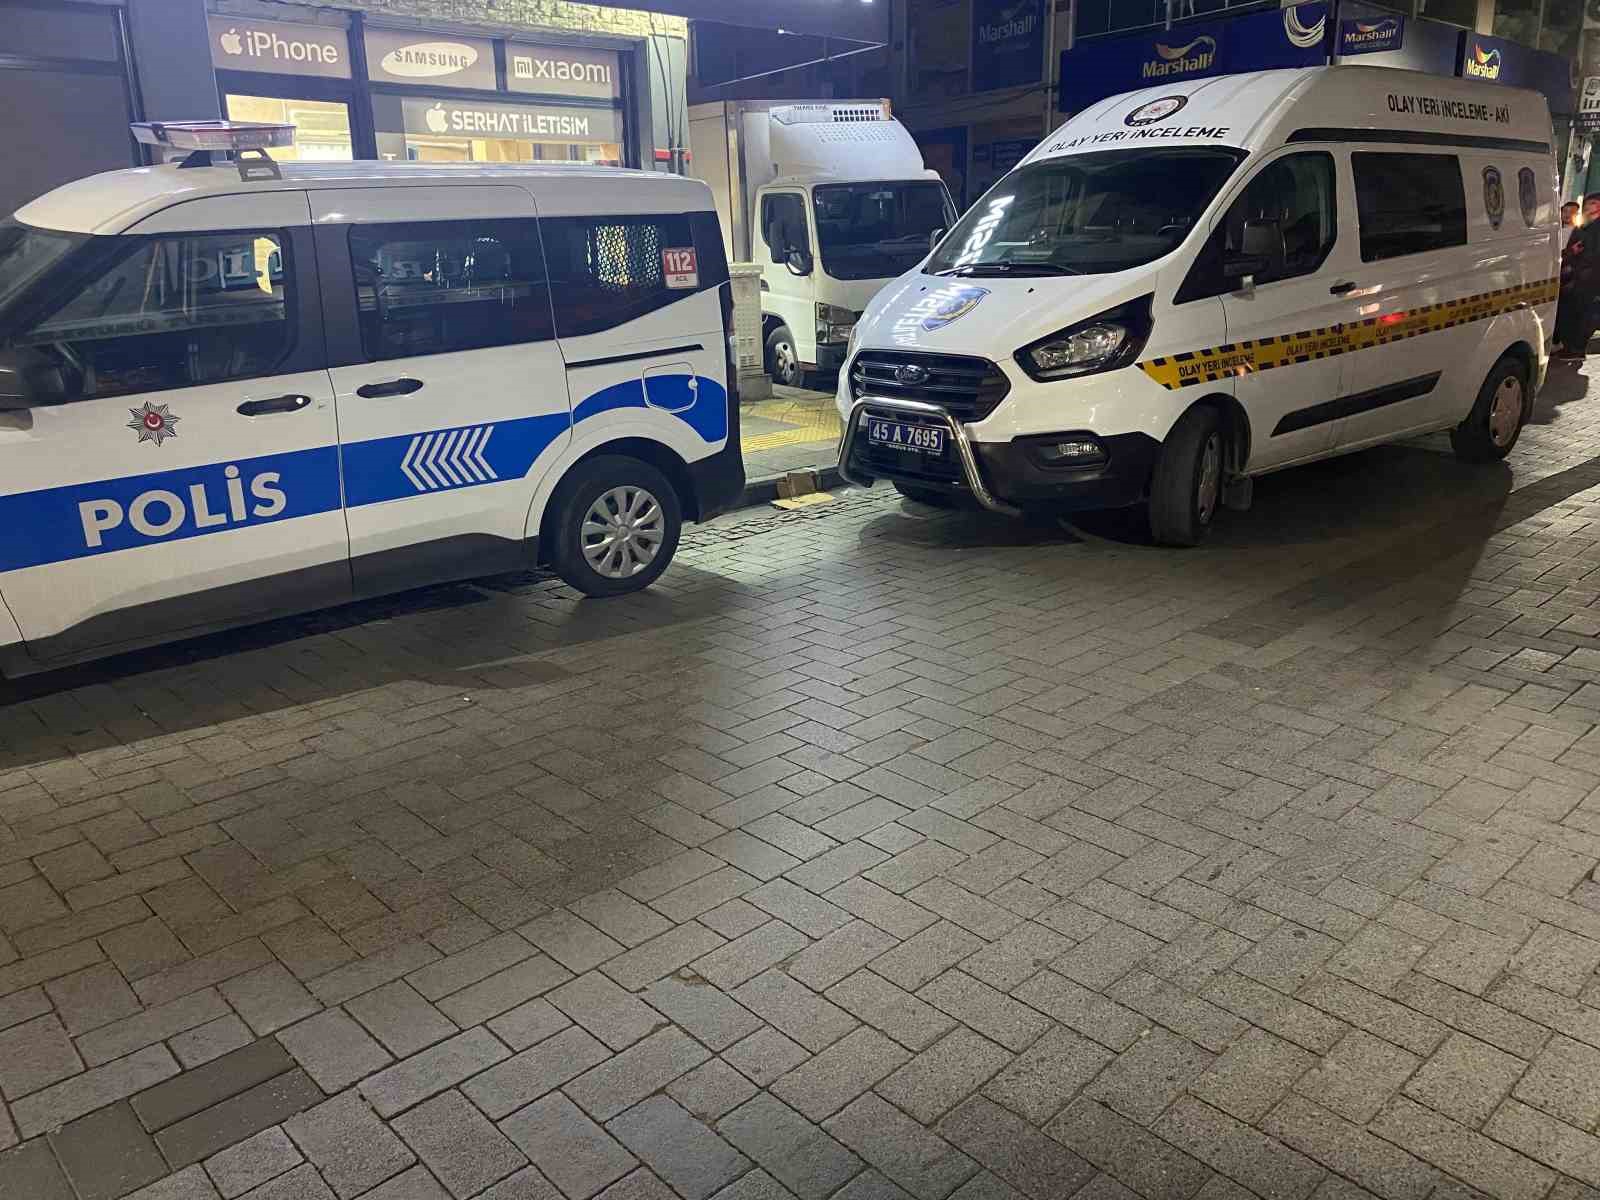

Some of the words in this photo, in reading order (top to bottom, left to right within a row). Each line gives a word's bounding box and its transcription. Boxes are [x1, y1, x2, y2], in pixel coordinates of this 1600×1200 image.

[1344, 30, 1393, 43] Marshall
[246, 31, 338, 64] iPhone
[394, 50, 470, 68] SAMSUNG
[1142, 54, 1211, 78] Marshall
[1466, 59, 1500, 79] Marshall
[1387, 94, 1418, 114] OLAY
[452, 111, 519, 133] SERHAT
[1049, 136, 1091, 152] OLAY
[667, 252, 692, 271] 112
[1178, 363, 1201, 378] OLAY
[873, 423, 889, 440] 45
[893, 425, 902, 442] A
[907, 427, 938, 448] 7695
[78, 465, 287, 548] POLİS
